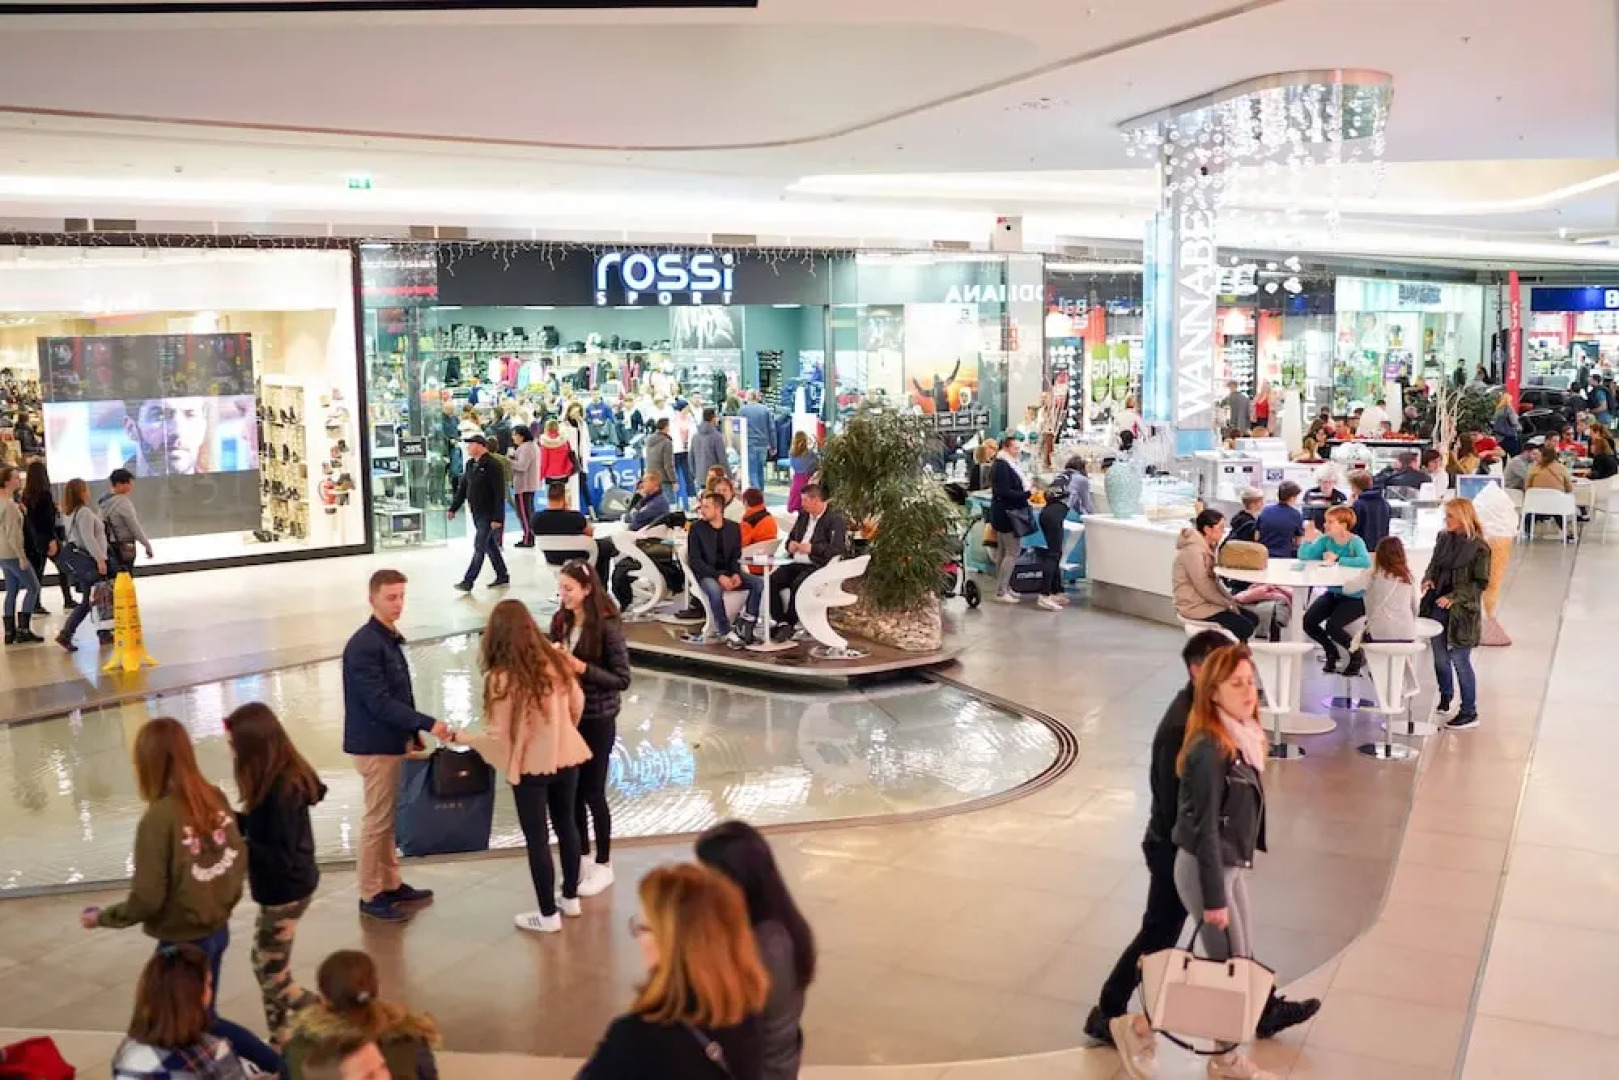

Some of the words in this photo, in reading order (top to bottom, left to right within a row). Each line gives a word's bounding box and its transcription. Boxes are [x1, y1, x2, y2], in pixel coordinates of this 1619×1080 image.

[597, 252, 734, 290] rossi
[597, 291, 732, 305] SPORT
[1177, 210, 1213, 422] WANNABE
